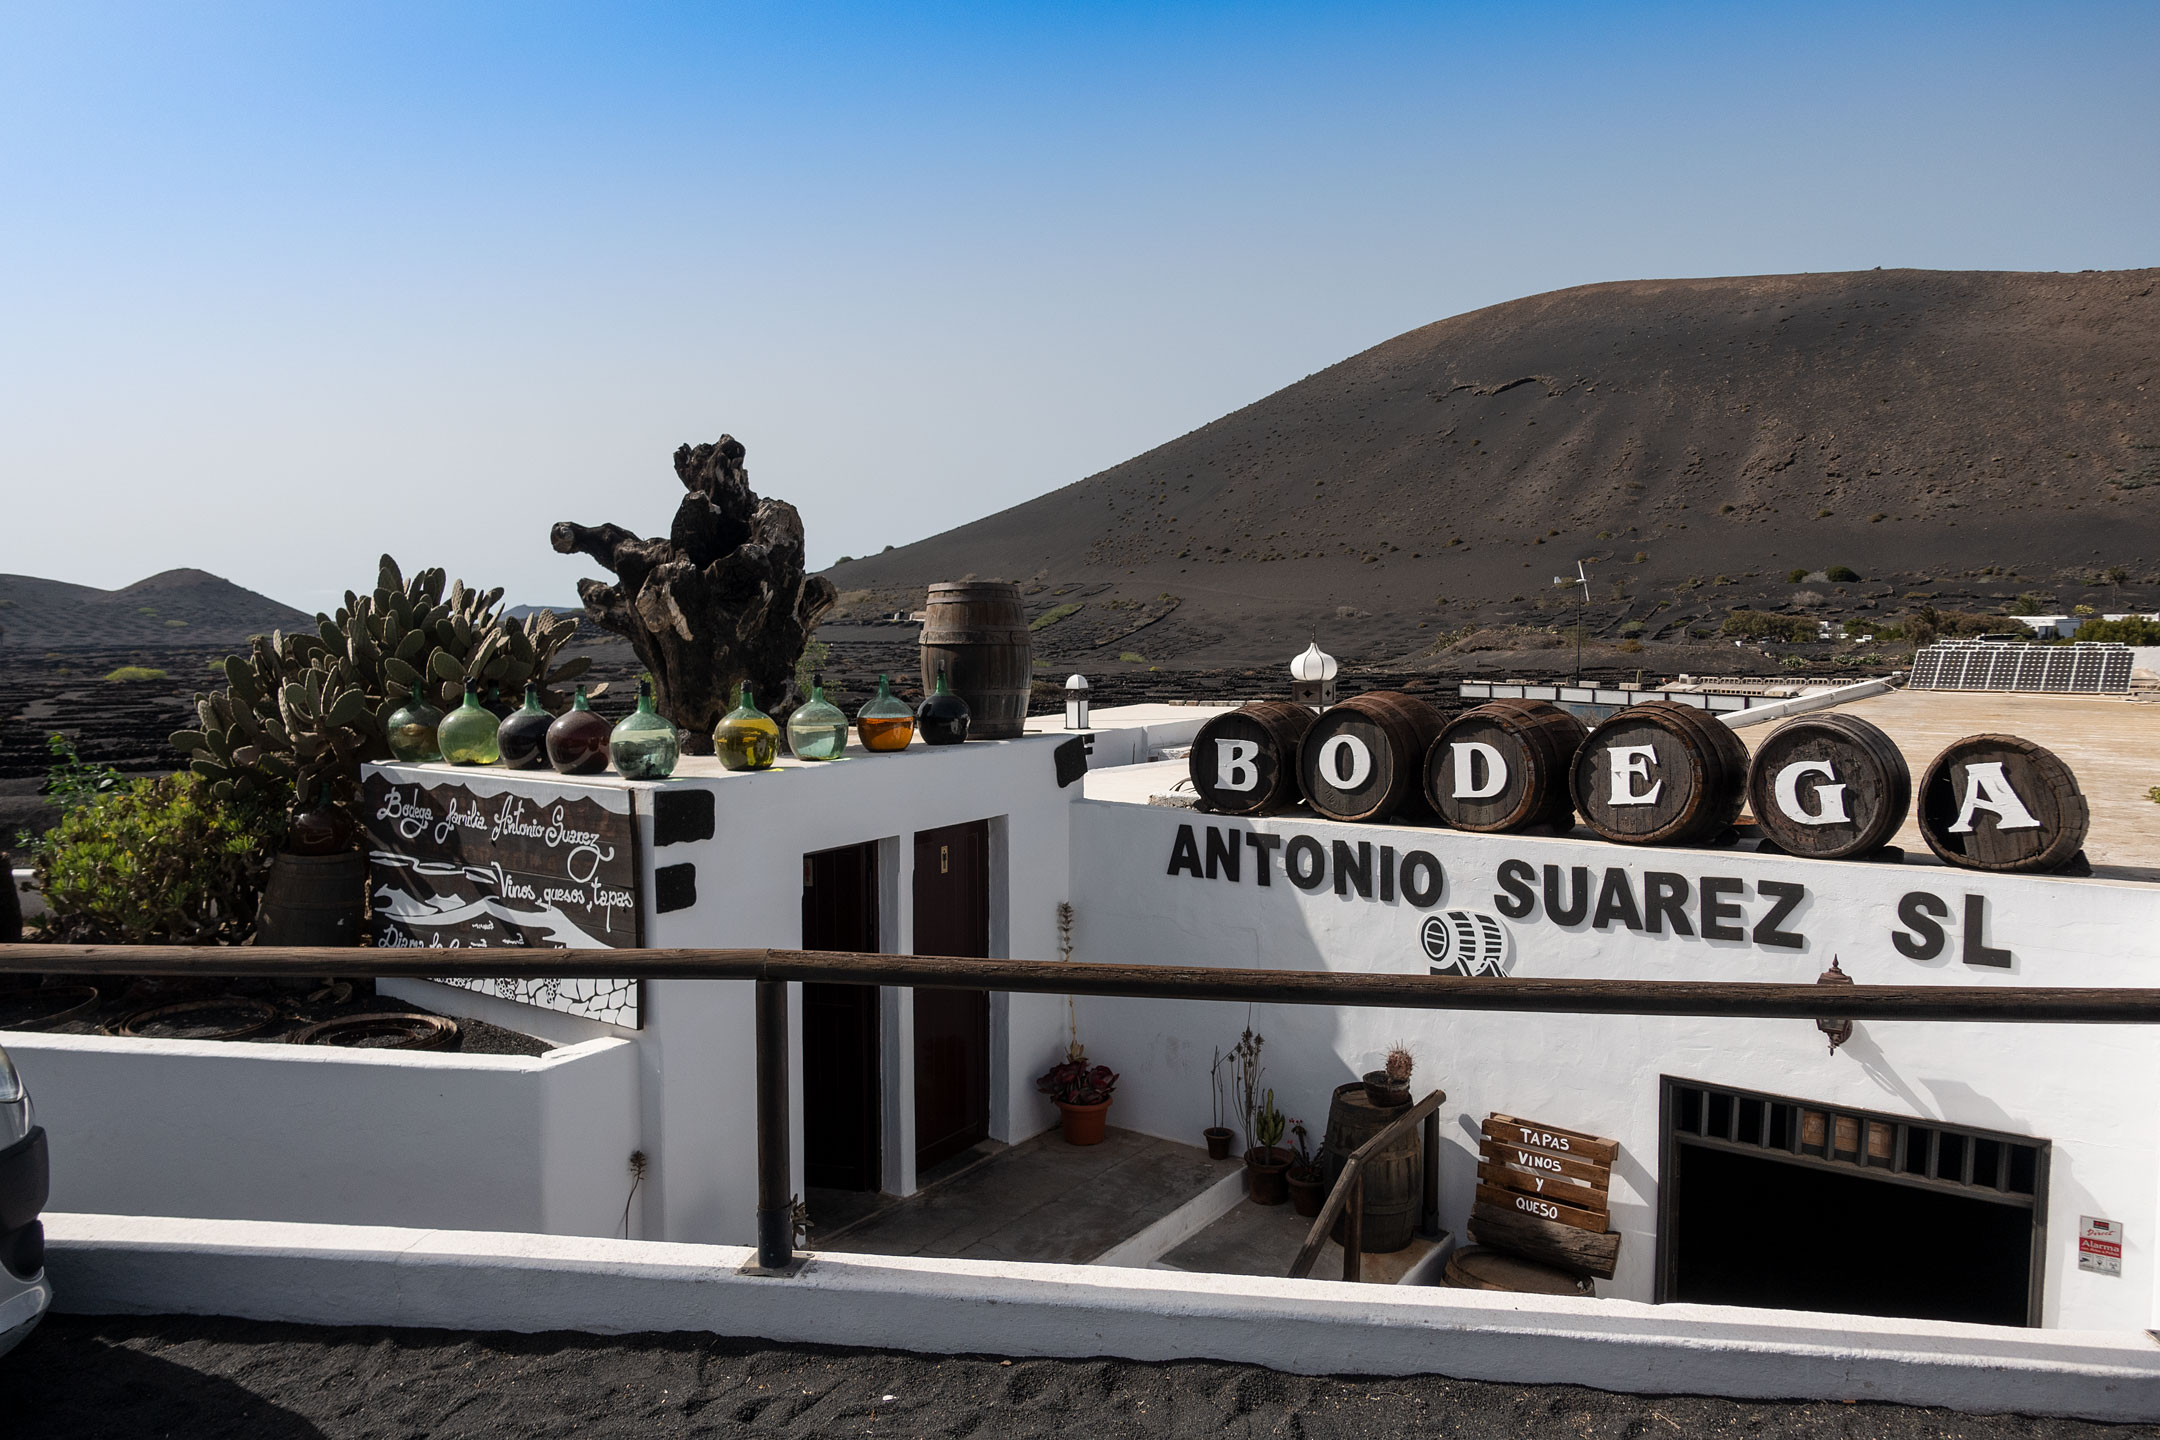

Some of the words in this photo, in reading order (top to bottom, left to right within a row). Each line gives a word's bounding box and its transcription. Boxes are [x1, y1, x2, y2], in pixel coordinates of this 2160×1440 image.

[1214, 734, 2041, 833] BODEGA
[377, 787, 434, 838] Bodega
[491, 795, 545, 840] Antonio
[545, 805, 615, 883] Suarez
[591, 876, 634, 933] tapas
[1167, 824, 1443, 907] ANTONIO
[1494, 859, 1804, 948] SUAREZ
[1892, 891, 2012, 968] SL
[1520, 1128, 1569, 1151] TAPAS
[1518, 1151, 1562, 1172] VINOS
[1516, 1197, 1558, 1219] QUESO
[2082, 1239, 2120, 1253] Alarma
